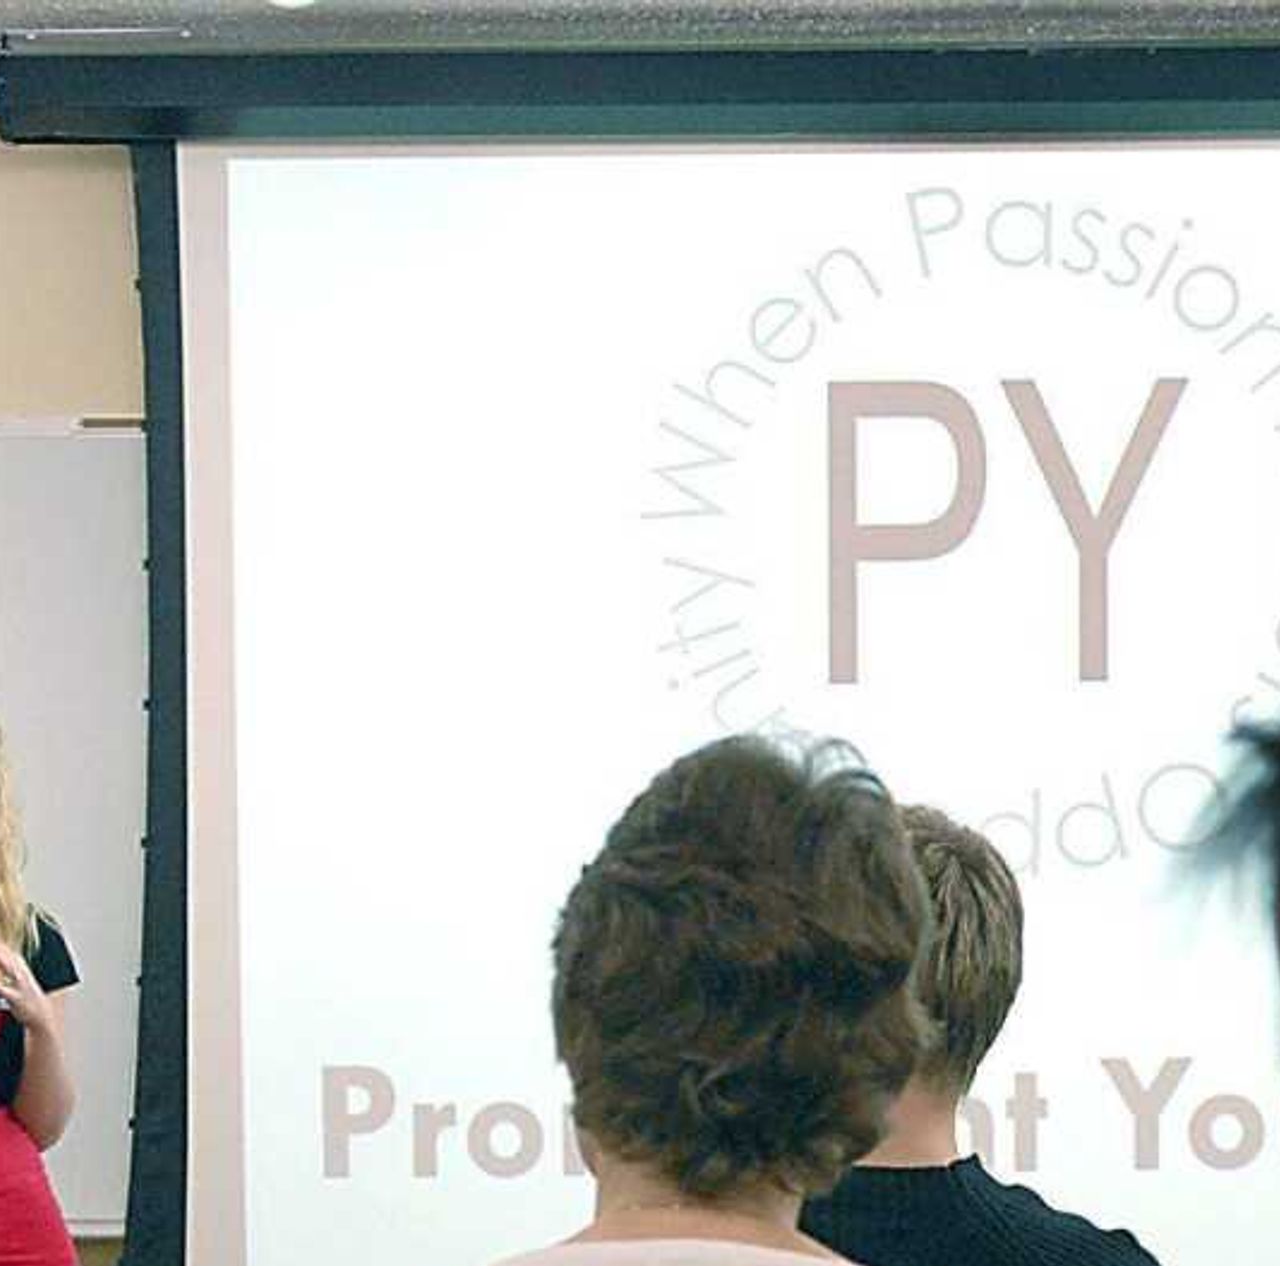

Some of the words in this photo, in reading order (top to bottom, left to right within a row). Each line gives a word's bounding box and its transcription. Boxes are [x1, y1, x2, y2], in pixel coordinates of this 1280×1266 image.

[640, 246, 883, 522] When
[826, 376, 1189, 684] PY
[321, 1064, 1049, 1179] Pront
